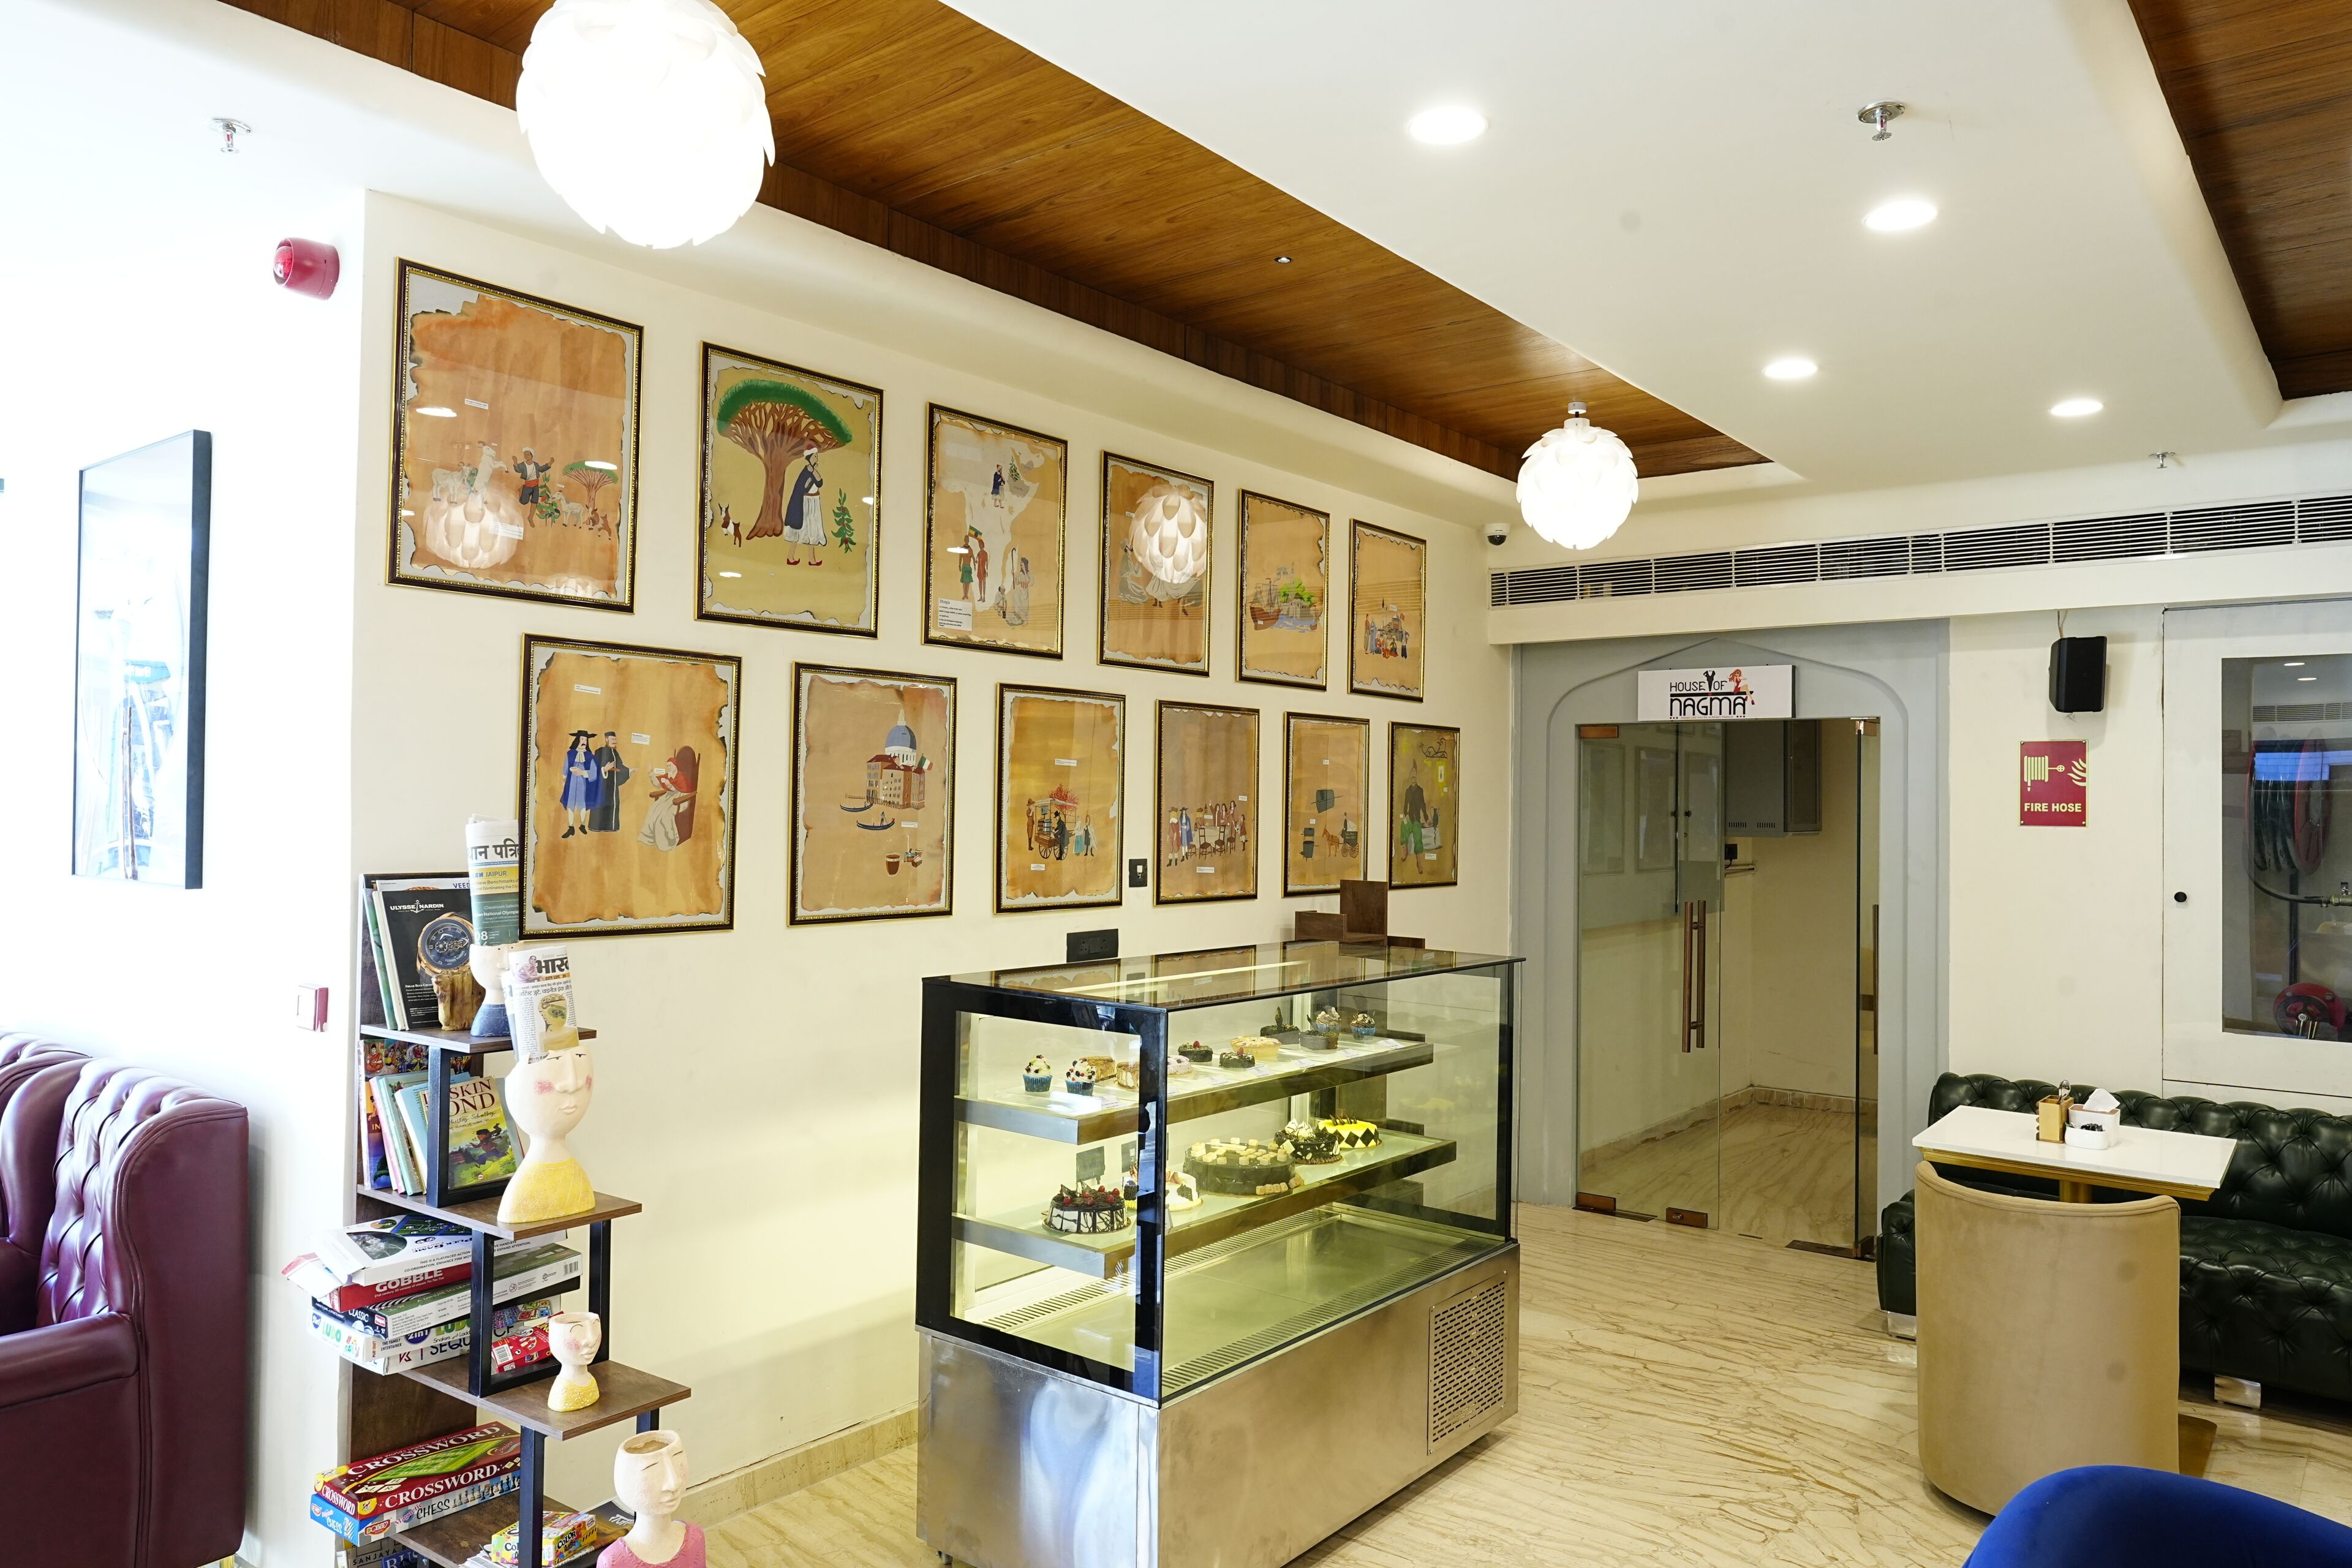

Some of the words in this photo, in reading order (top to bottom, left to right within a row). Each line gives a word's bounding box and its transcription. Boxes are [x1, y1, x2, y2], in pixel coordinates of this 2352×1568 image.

[1670, 681, 1706, 692] HOUSE
[1713, 680, 1728, 691] OF
[1670, 696, 1746, 716] NAGMA
[2024, 803, 2049, 812] FIRE
[2052, 803, 2082, 812] HOSE
[436, 1253, 456, 1262] FLAT-PACED
[375, 1268, 443, 1292] GOBBLE
[423, 1292, 445, 1300] MINUTE
[348, 1309, 369, 1322] CLASSIC
[322, 1322, 342, 1343] LUDO
[380, 1343, 402, 1351] ENTERTAINER
[347, 1426, 501, 1476] CROSSWORD
[385, 1464, 497, 1508] CROSSWORD
[322, 1485, 355, 1515] CROSSWORD
[394, 1502, 423, 1526] Magnetic
[417, 1499, 450, 1520] CHESS
[326, 1517, 342, 1534] CHESS
[353, 1548, 398, 1566] SANJAYA
